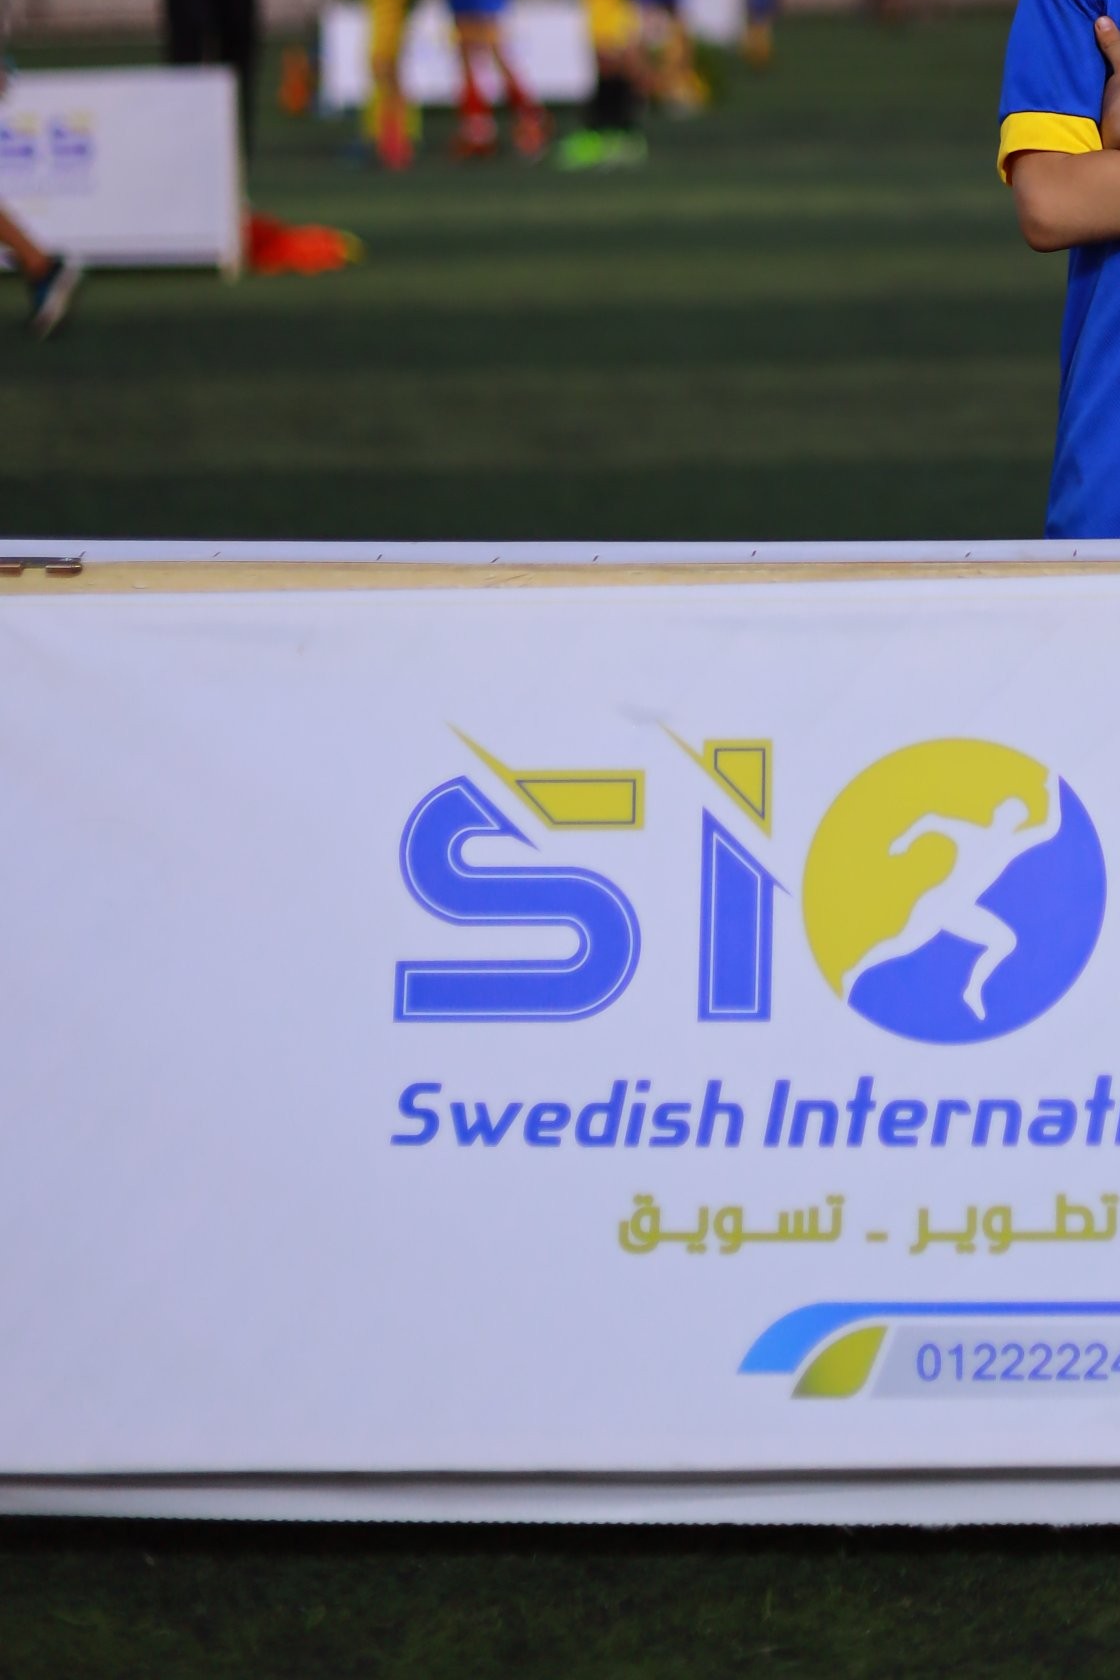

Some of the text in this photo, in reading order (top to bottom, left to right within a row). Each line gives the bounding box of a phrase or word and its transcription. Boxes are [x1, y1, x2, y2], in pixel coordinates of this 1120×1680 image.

[390, 1080, 744, 1148] Swedish
[618, 1193, 845, 1255] تسويق
[909, 1193, 1120, 1255] تطوير
